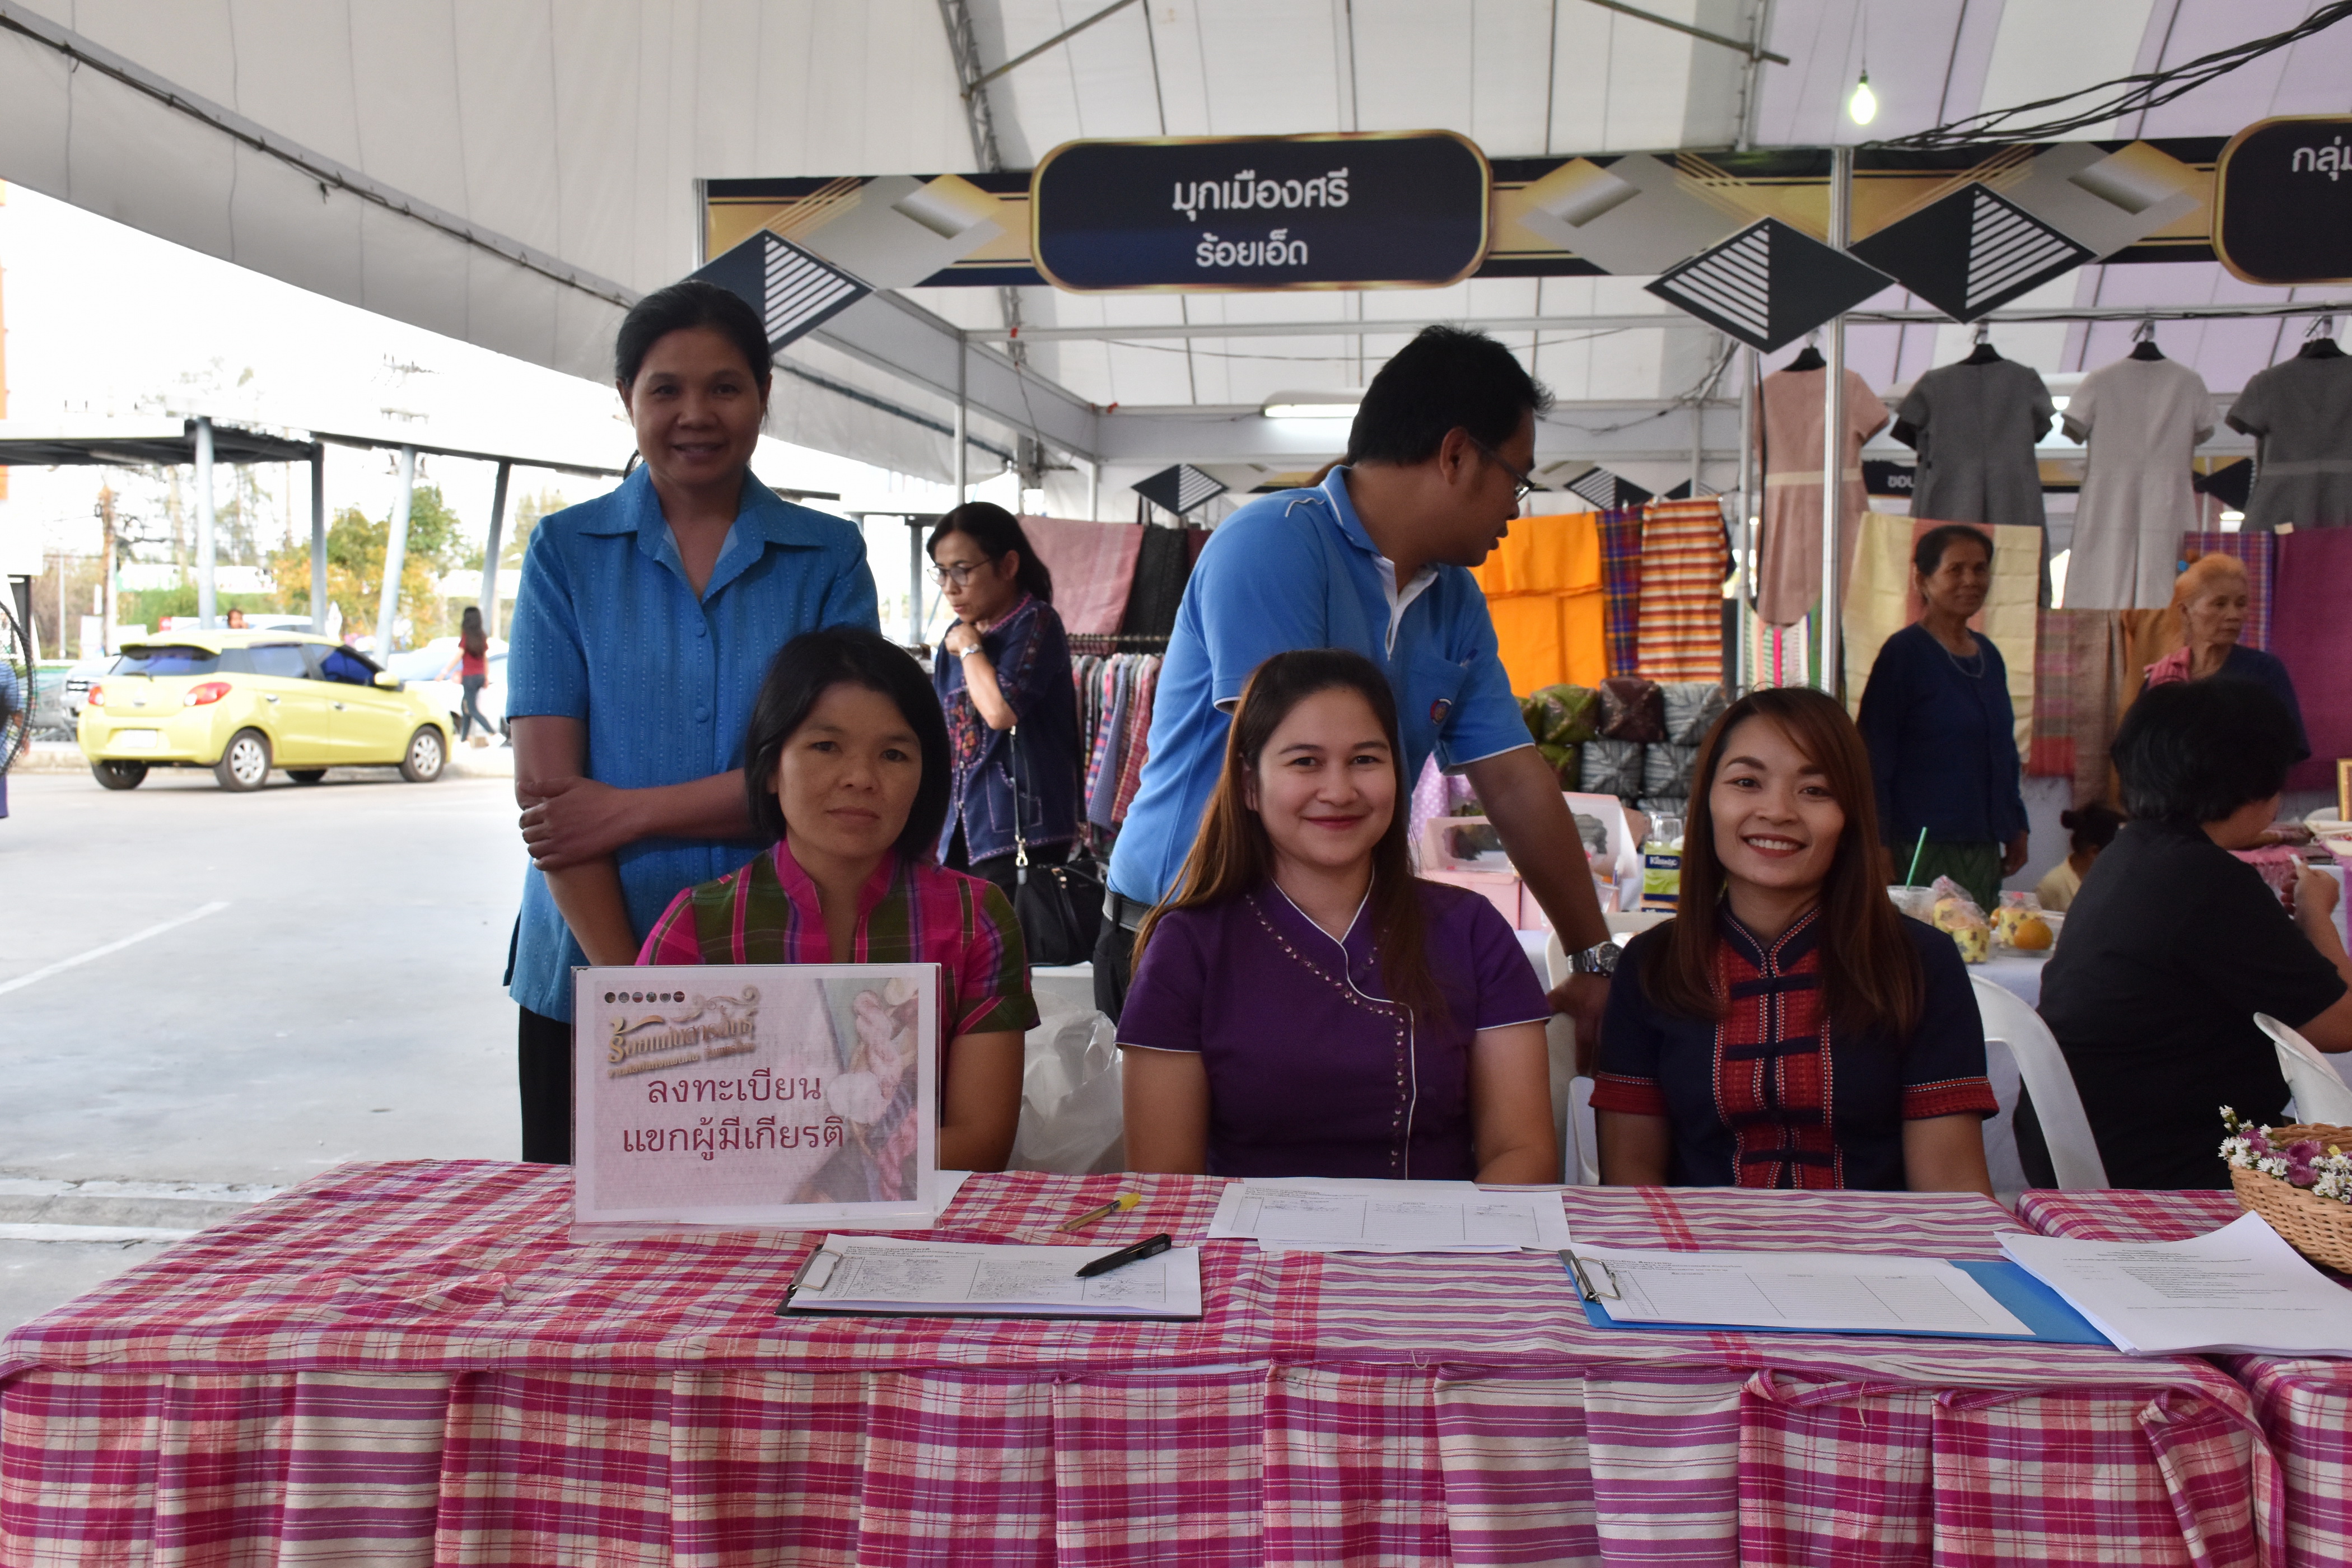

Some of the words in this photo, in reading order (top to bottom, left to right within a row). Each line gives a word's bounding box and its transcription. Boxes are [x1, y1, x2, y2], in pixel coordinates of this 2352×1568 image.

[1172, 167, 1350, 222] มุกเมืองศรี
[1195, 228, 1309, 268] ร้อยเอ็ด
[647, 1067, 822, 1103] ลงทะเบียน
[623, 1116, 844, 1161] แขกผู้มีเกียรติ
